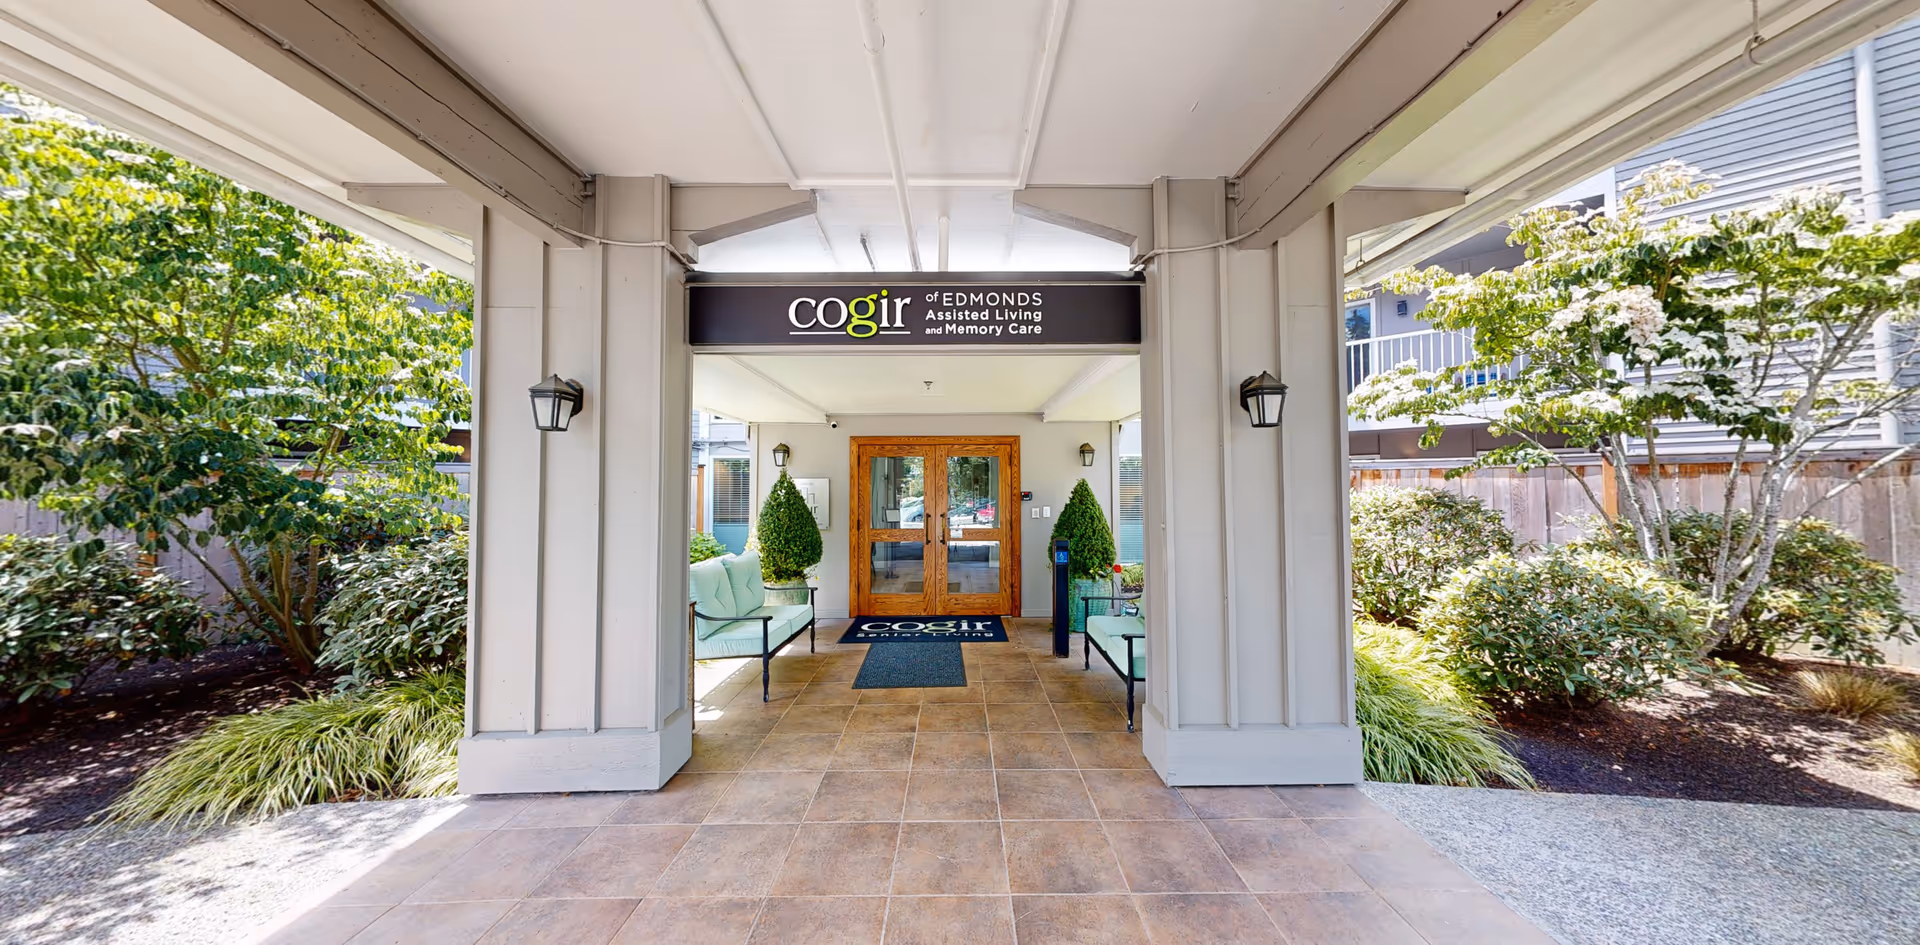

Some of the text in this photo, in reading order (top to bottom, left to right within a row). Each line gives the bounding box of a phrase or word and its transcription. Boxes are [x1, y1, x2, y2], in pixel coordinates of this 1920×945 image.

[925, 291, 1042, 306] of EDMONDS
[788, 289, 912, 338] cogir
[925, 309, 1042, 323] Assisted Living
[925, 323, 1042, 336] and Memory Care
[860, 620, 992, 634] cogir
